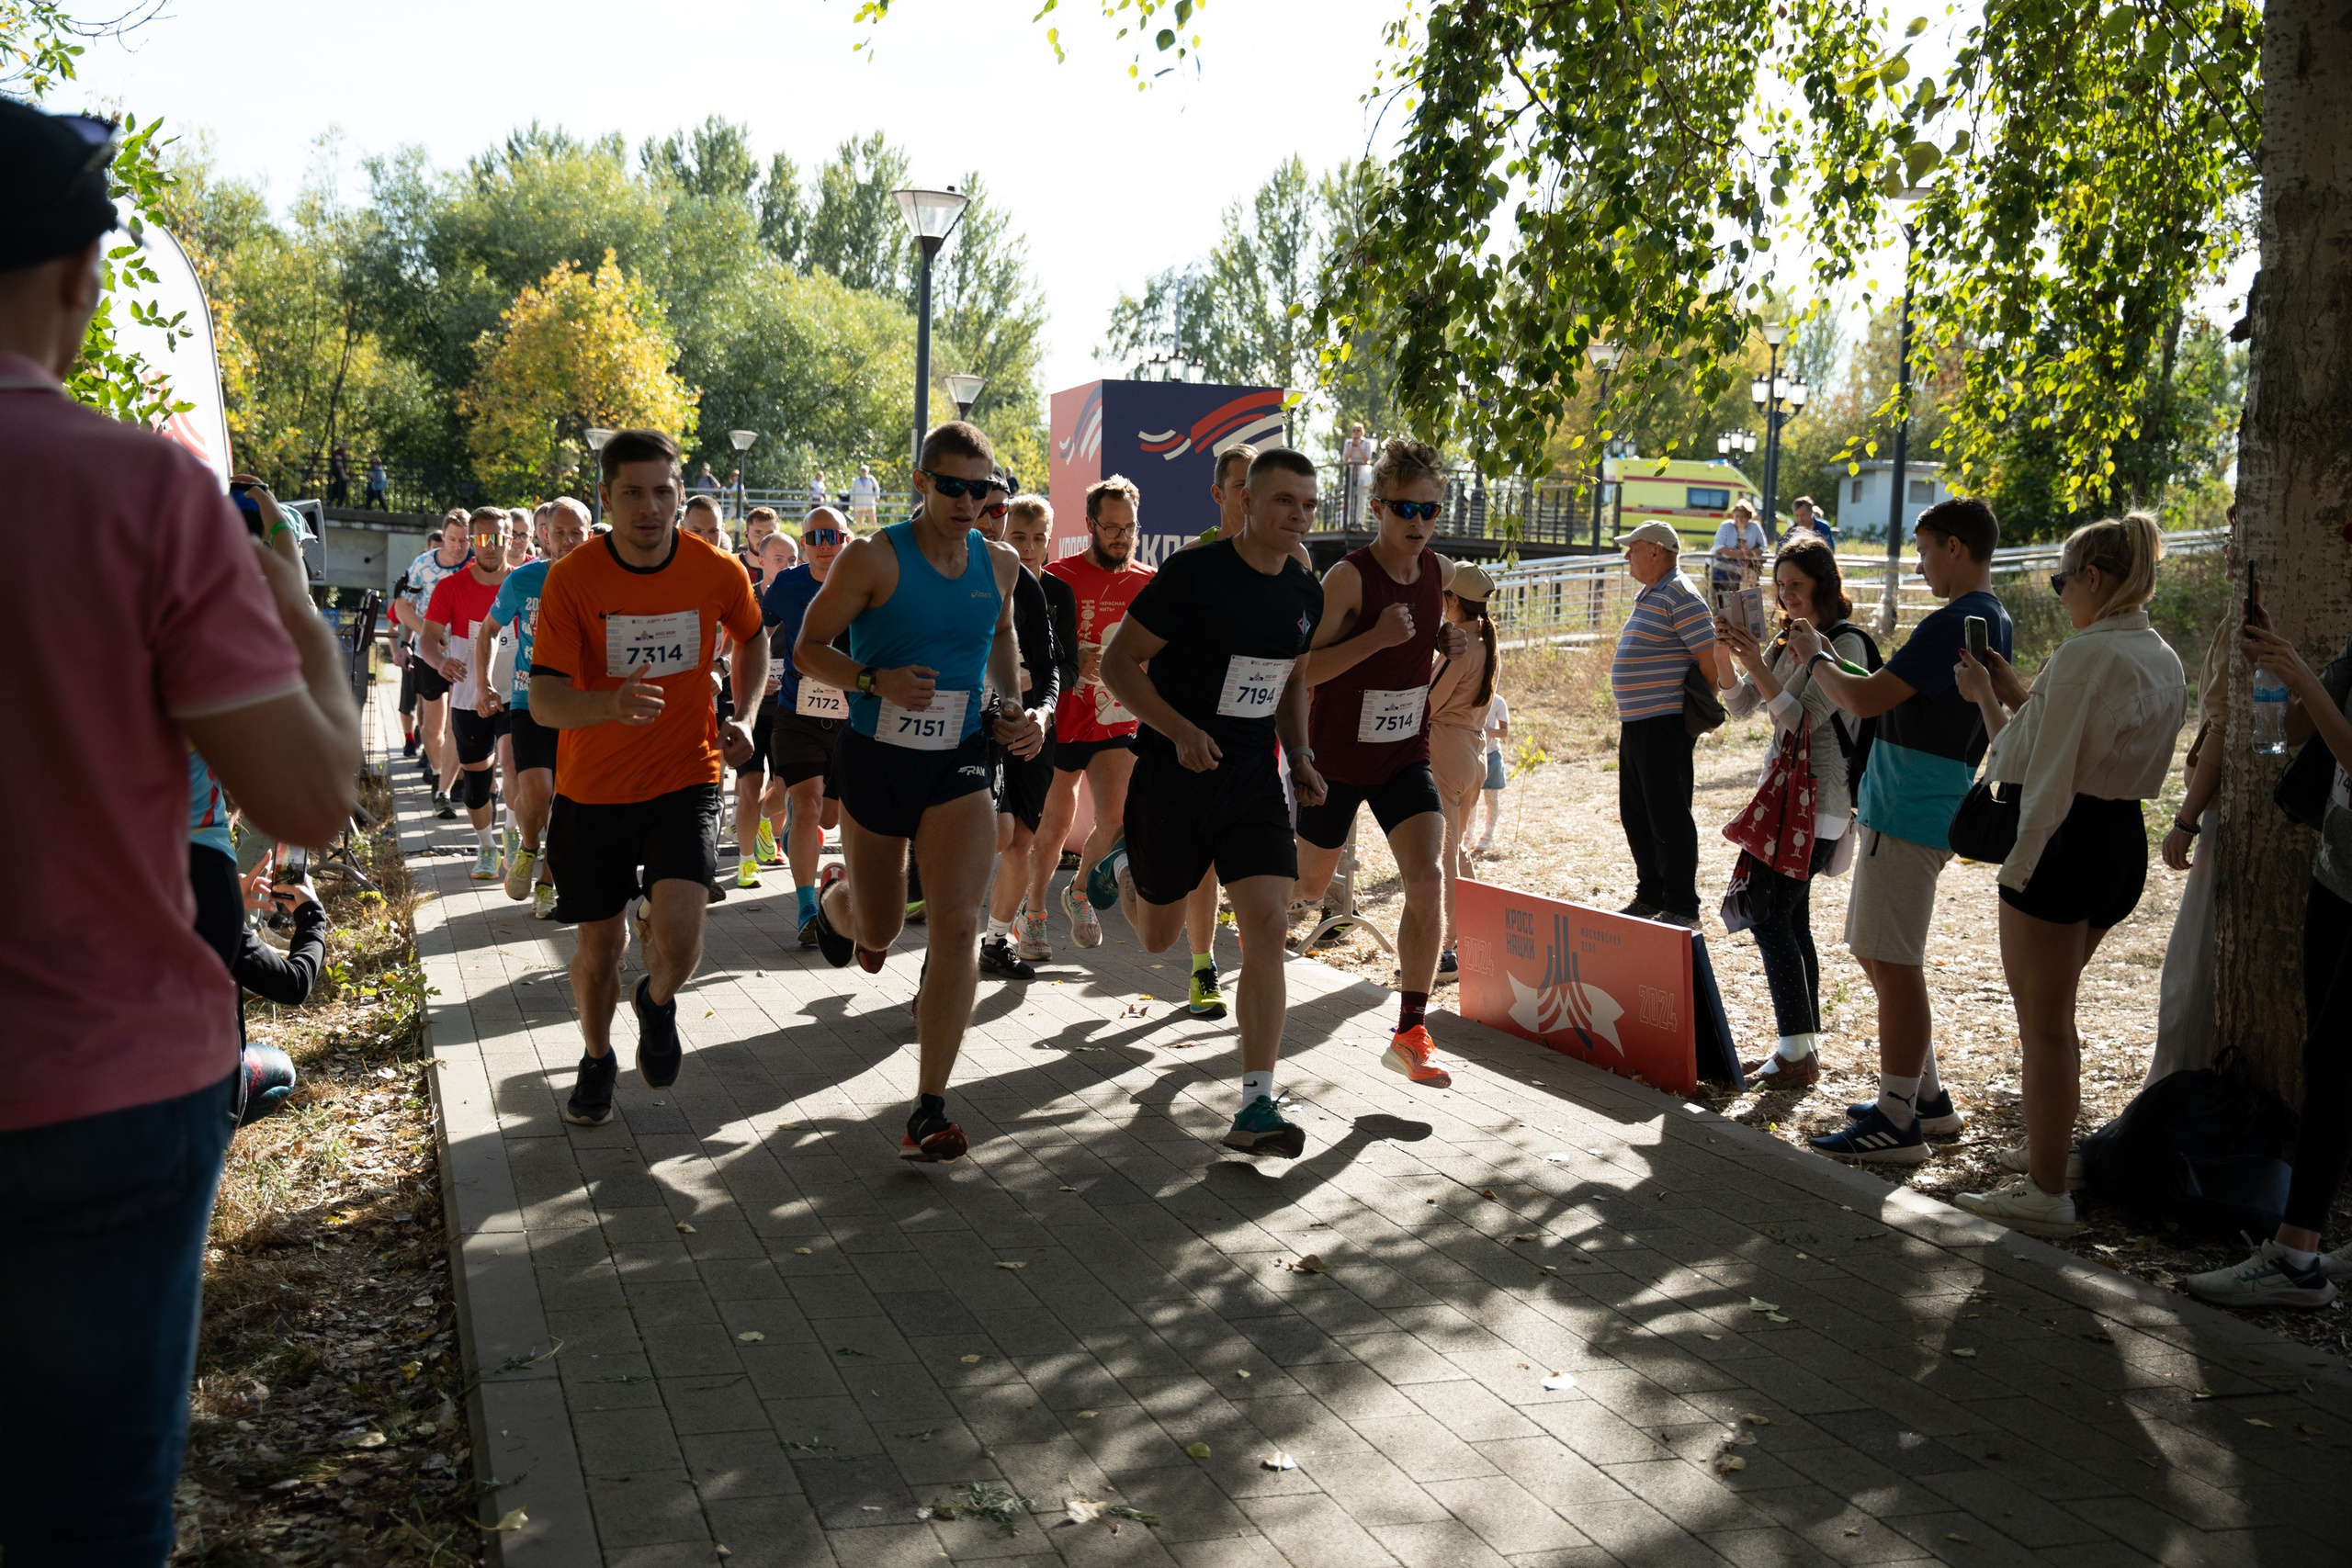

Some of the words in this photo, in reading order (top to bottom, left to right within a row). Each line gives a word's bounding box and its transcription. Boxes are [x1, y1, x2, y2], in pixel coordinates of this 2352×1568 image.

[626, 644, 683, 665] 7314
[808, 695, 840, 710] 7172
[1236, 686, 1276, 705] 7194
[898, 716, 945, 737] 7151
[1374, 712, 1413, 731] 7514
[1505, 908, 1534, 935] КРОСС
[1464, 937, 1495, 976] 2024
[1506, 932, 1535, 961] НАЦИИ
[1638, 984, 1678, 1032] 2024
[2012, 1190, 2028, 1199] FILA
